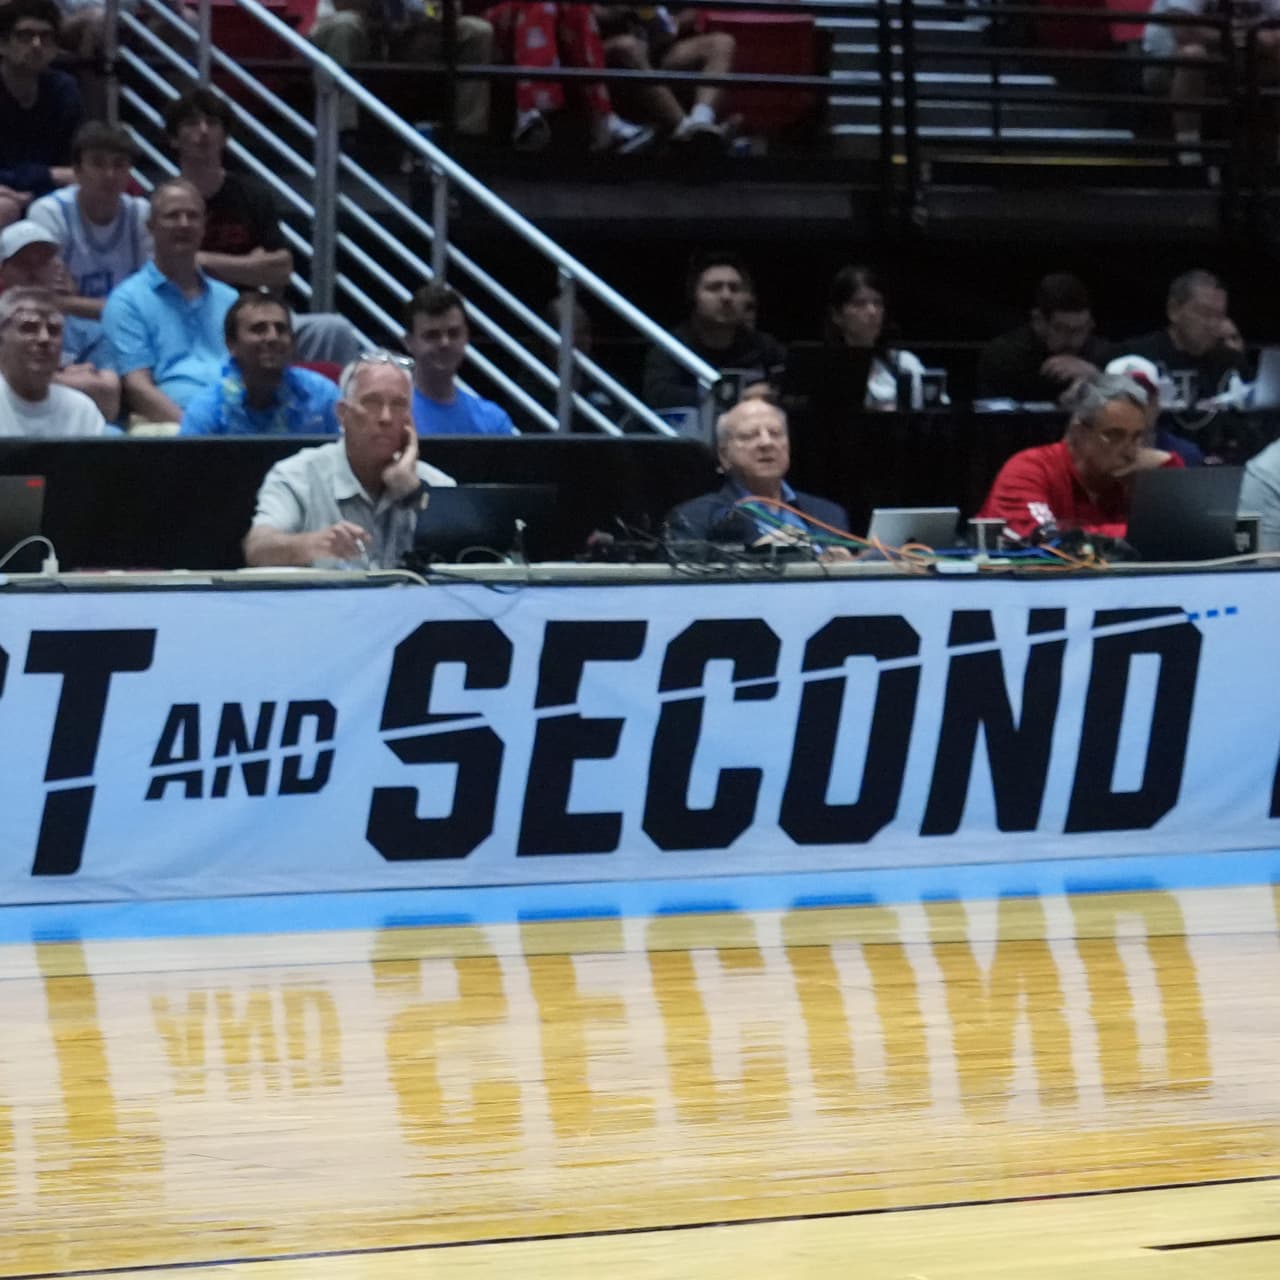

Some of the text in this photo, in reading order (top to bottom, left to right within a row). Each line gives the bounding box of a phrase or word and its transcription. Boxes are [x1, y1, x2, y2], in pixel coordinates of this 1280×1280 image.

[0, 628, 158, 876] T
[144, 699, 339, 801] AND
[366, 607, 1202, 862] SECOND
